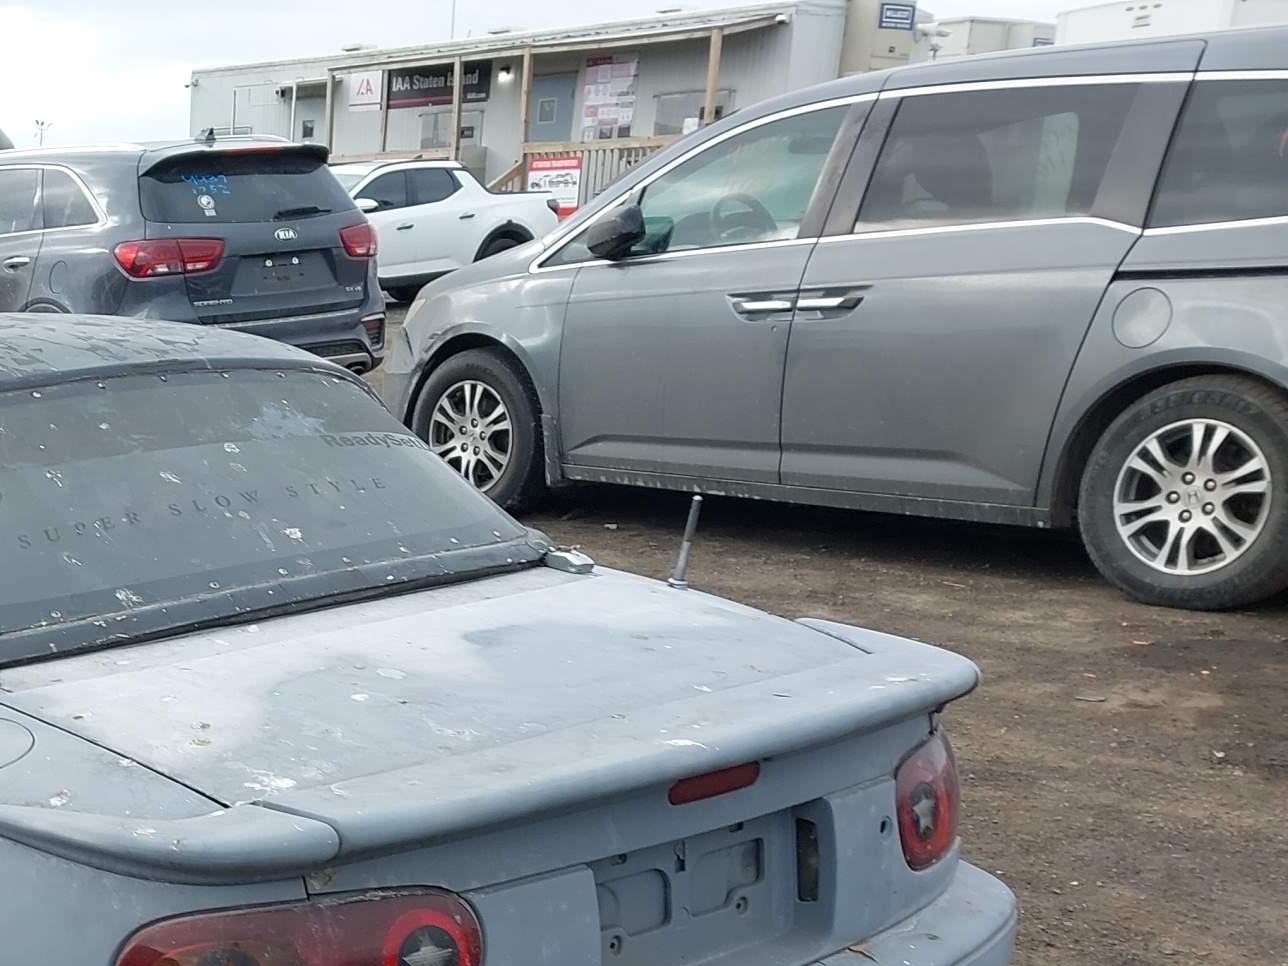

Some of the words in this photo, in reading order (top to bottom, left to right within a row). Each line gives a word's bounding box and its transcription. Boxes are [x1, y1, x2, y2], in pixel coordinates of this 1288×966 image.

[392, 76, 410, 92] IAA
[412, 74, 444, 90] Staten
[277, 229, 296, 240] KIA
[168, 489, 259, 517] SLOW
[285, 476, 387, 499] STYLE
